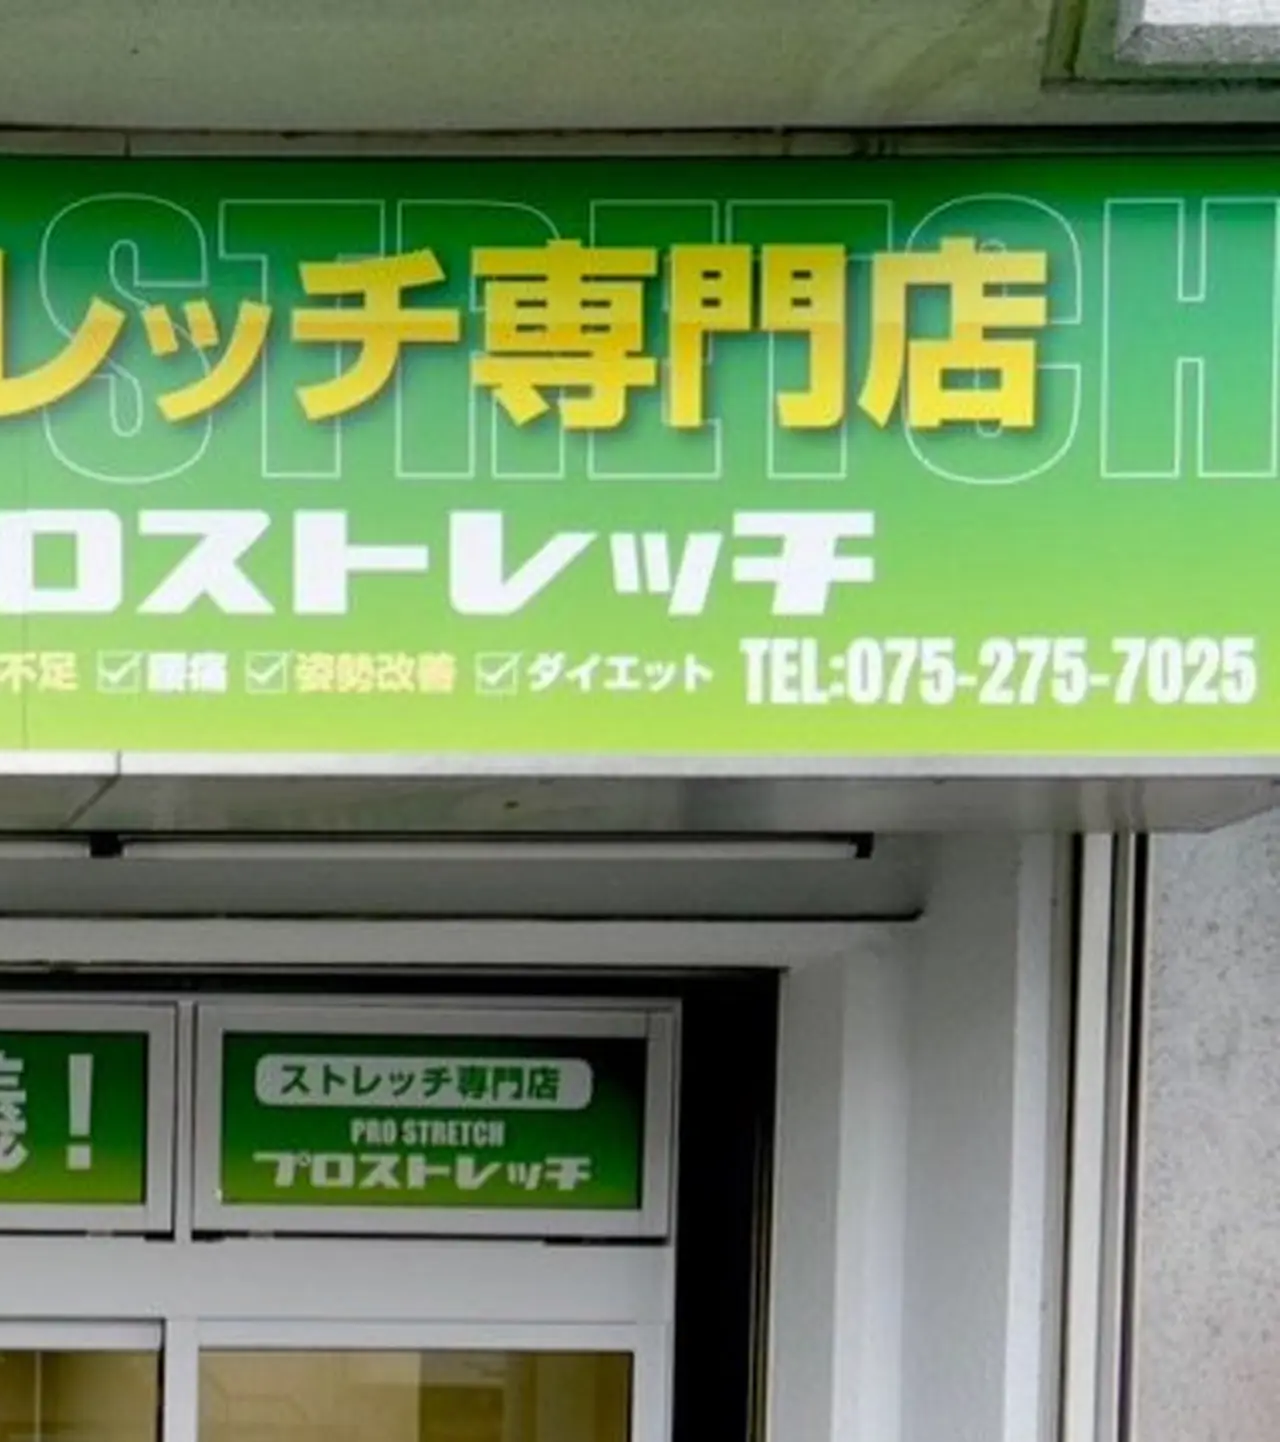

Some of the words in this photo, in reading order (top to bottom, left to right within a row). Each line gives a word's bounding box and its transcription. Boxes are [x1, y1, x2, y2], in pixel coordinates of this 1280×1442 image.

[529, 651, 714, 694] ダイエット
[740, 636, 1259, 706] TEL:075-275-7025
[280, 1064, 562, 1100] ストレッチ専門店
[350, 1117, 395, 1145] PRO
[401, 1119, 505, 1147] STRETCH
[252, 1150, 593, 1191] プロストレッチ
